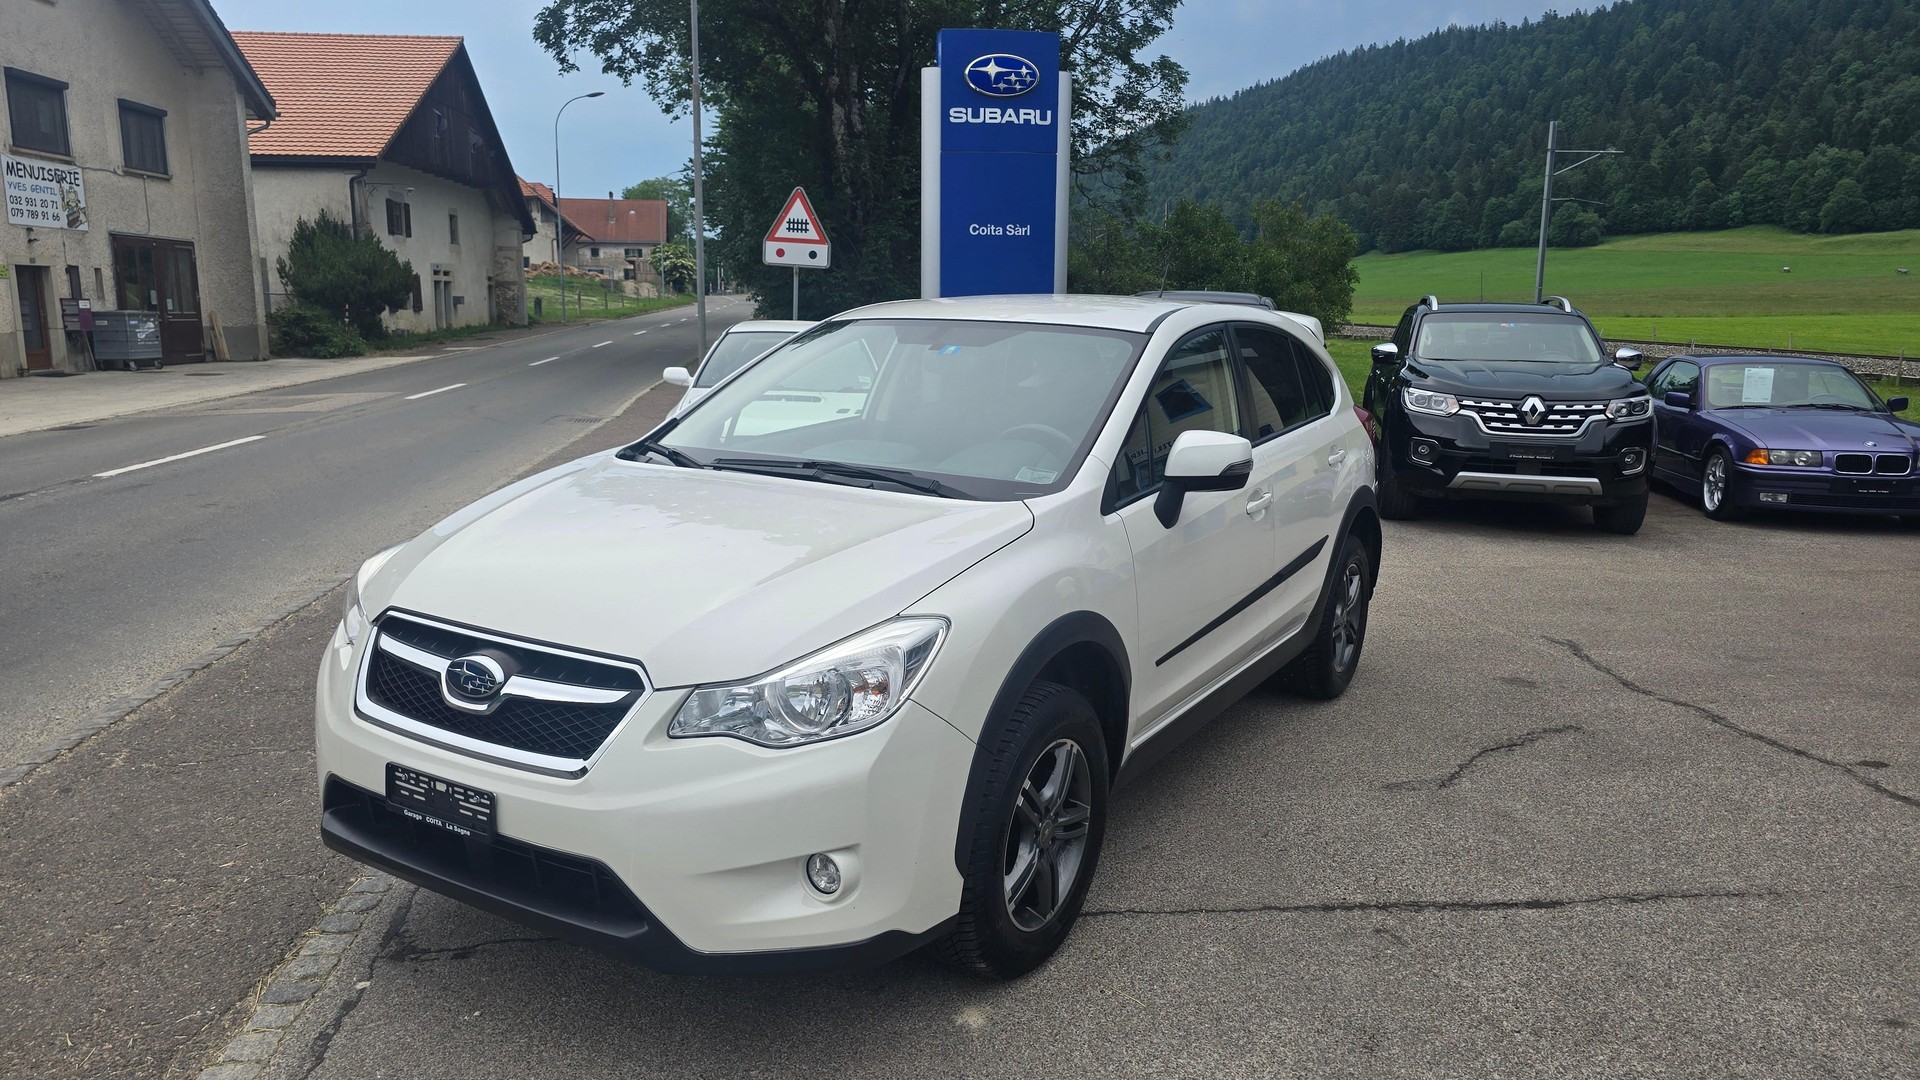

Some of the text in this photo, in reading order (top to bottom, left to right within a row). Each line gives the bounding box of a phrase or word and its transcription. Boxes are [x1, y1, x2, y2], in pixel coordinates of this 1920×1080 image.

[949, 107, 1051, 125] SUBARU
[6, 161, 80, 187] MENUISERIE
[7, 181, 57, 195] YVES GENTIL
[9, 195, 58, 209] 032 931 20 71
[11, 207, 60, 221] 079 789 91 66
[969, 223, 1030, 236] Coita Sàrl
[404, 809, 422, 820] Garage
[426, 817, 442, 827] COITA
[454, 826, 470, 836] Sagne
